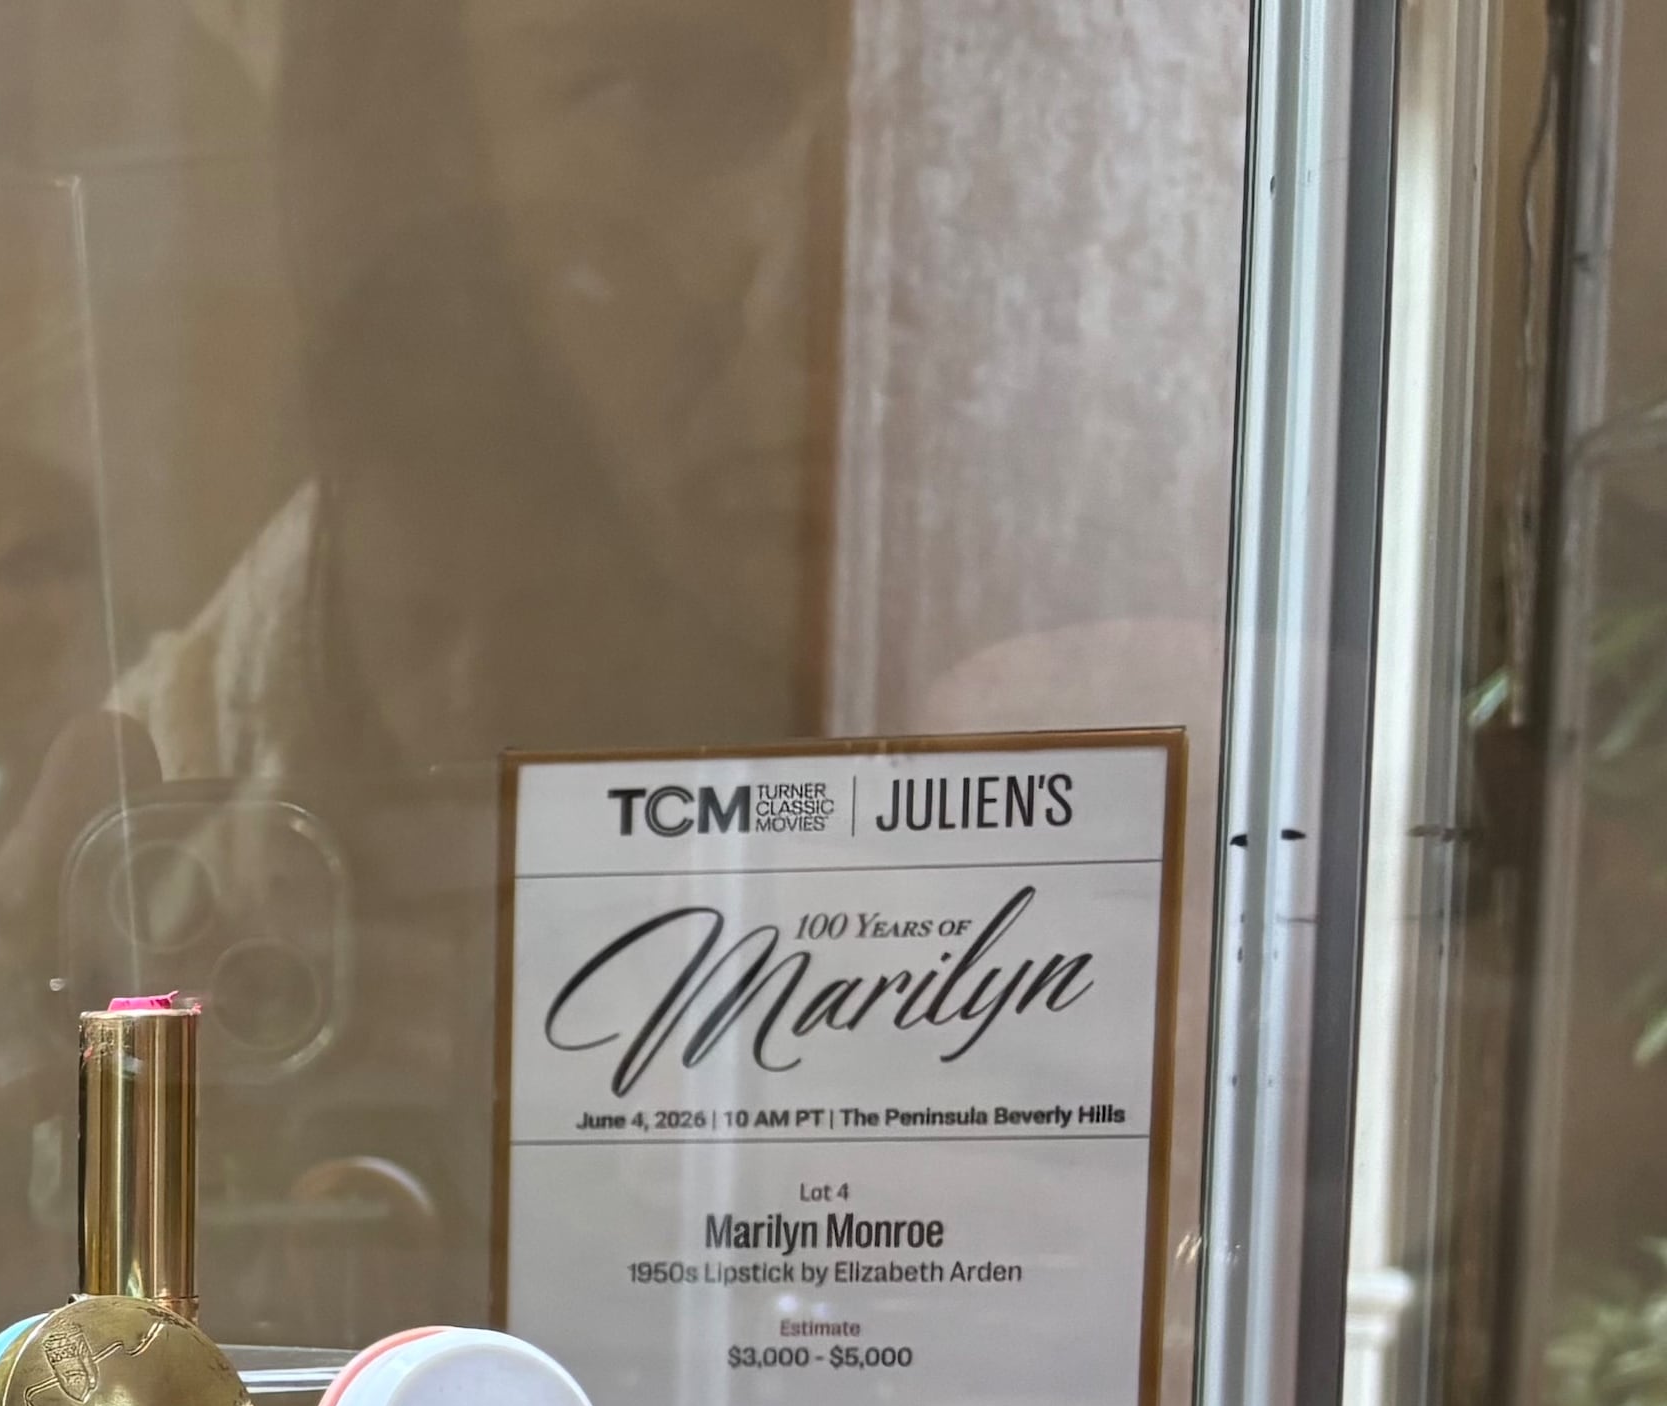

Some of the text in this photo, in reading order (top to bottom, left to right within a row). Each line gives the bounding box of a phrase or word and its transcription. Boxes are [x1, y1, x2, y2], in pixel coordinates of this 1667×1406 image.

[757, 783, 827, 799] TURNER
[876, 773, 1073, 832] JULIEN'S
[607, 785, 751, 838] TCM
[756, 799, 834, 816] CLASSIC
[756, 816, 826, 832] MOVIES
[795, 912, 848, 940] 100
[545, 885, 1095, 1098] Marilyn
[576, 1111, 626, 1130] June
[631, 1111, 649, 1132] 4,
[654, 1110, 706, 1129] 2026
[724, 1109, 749, 1128] 10
[754, 1109, 790, 1127] AM
[795, 1109, 825, 1127] PT
[840, 1108, 880, 1127] The
[885, 1106, 988, 1126] Peninsula
[994, 1105, 1072, 1128] Beverly
[1078, 1104, 1126, 1123] Hills
[800, 1183, 850, 1202] Lot 4
[705, 1212, 945, 1256] Marilyn Monroe
[626, 1260, 1023, 1288] 1950s Lipstick by Elizabeth Arden
[779, 1318, 862, 1338] Estimate
[728, 1344, 809, 1369] $3,000
[830, 1344, 913, 1368] $5,000
